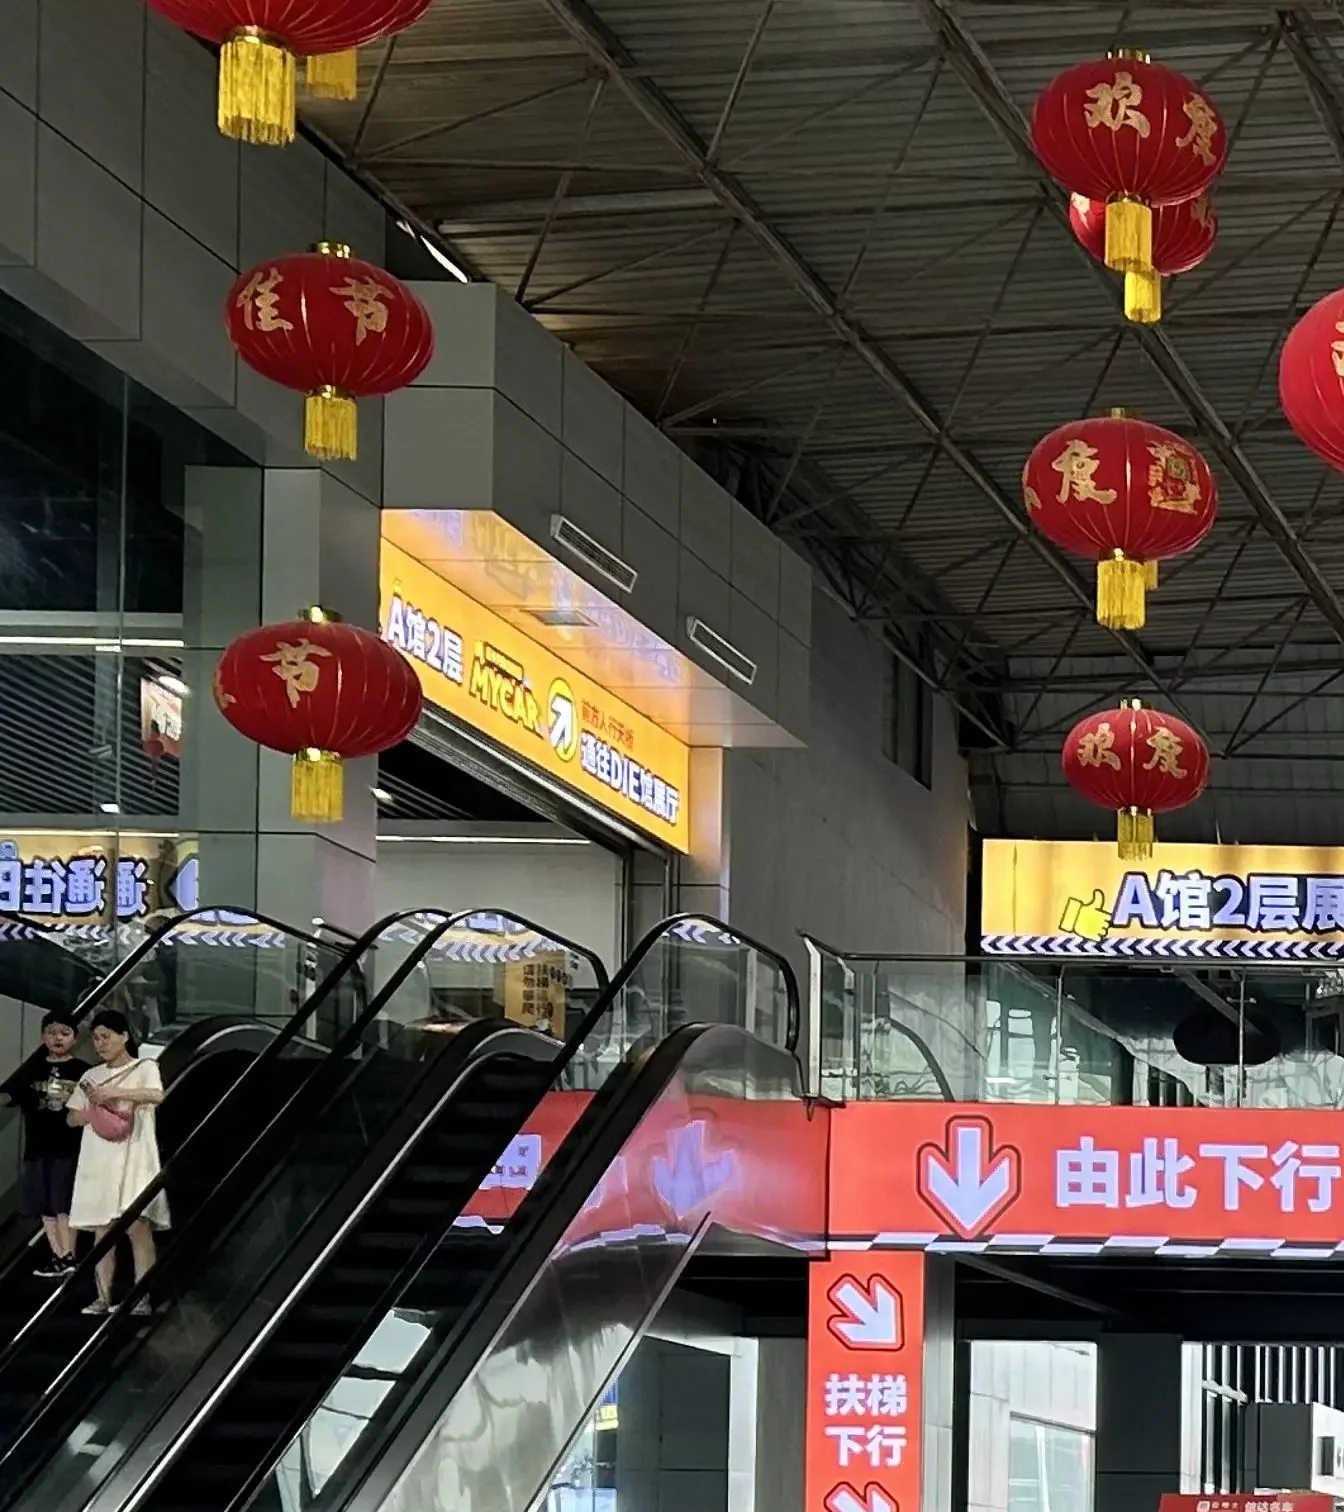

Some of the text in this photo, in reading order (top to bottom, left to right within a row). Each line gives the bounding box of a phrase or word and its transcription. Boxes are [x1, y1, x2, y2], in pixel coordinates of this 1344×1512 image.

[469, 658, 544, 740] MYCAR
[1055, 1136, 1342, 1212] 由此下行
[824, 1372, 908, 1417] 扶梯
[824, 1425, 908, 1467] 下行
